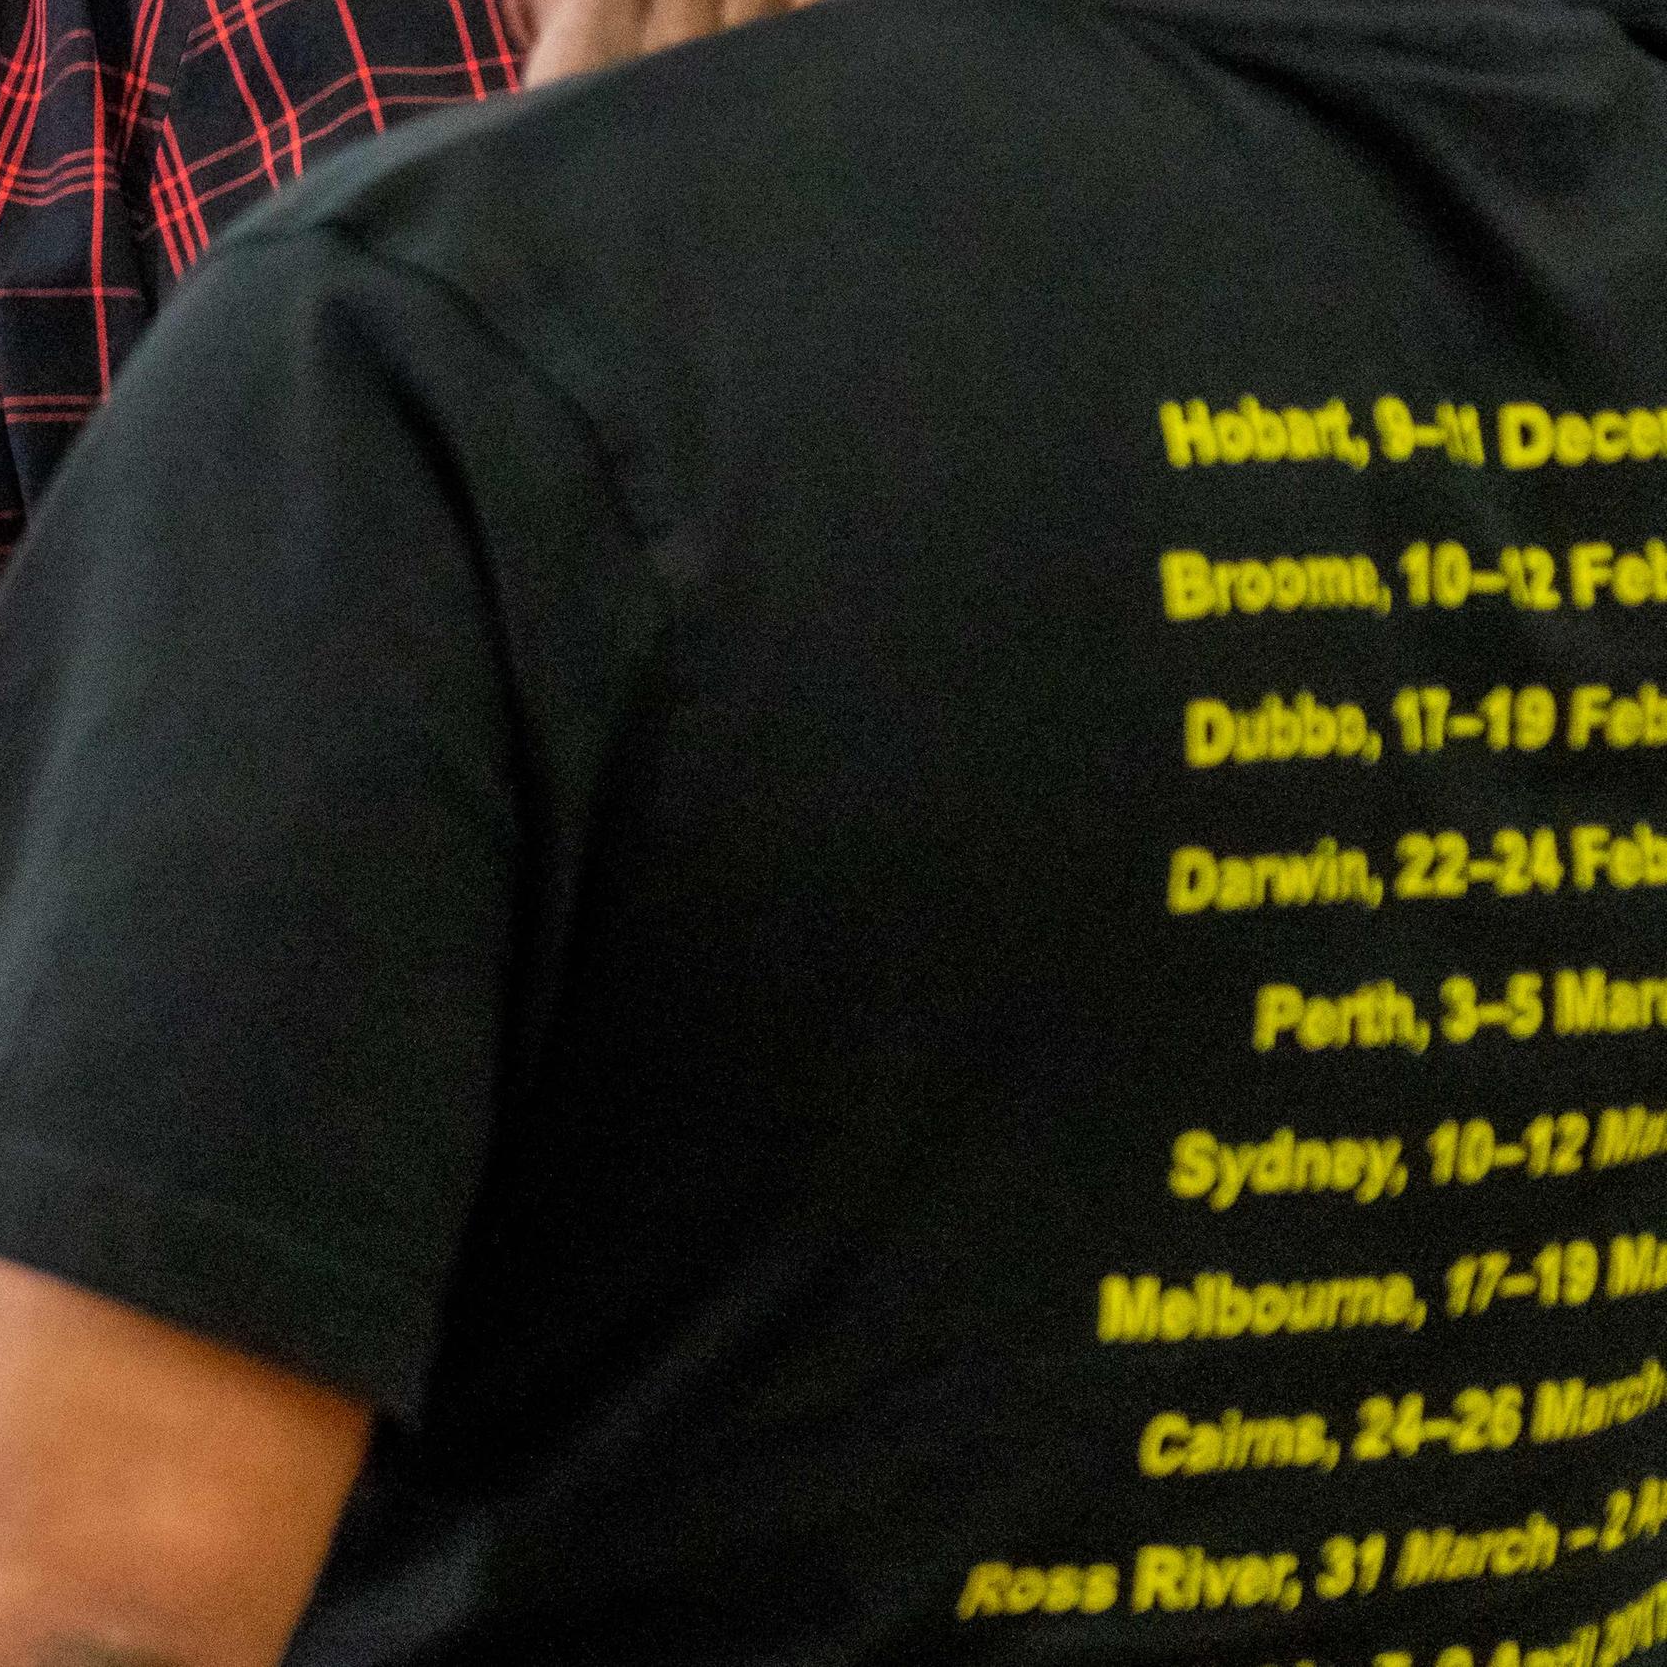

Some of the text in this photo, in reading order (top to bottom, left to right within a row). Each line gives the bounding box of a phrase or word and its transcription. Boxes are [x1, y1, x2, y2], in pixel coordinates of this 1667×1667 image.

[1160, 396, 1370, 469] Hobart,
[1497, 401, 1667, 470] Dece
[1160, 550, 1392, 621] Broome,
[1185, 692, 1382, 767] Dubbo,
[1168, 838, 1383, 914] Darwin,
[1254, 980, 1430, 1051] Perth,
[1170, 1129, 1408, 1210] Sydney,
[1098, 1273, 1427, 1342] Melbourne,
[1140, 1410, 1340, 1477] Cairns,
[959, 1562, 1119, 1618] Ross
[1133, 1545, 1302, 1613] River,
[1395, 1513, 1560, 1590] March
